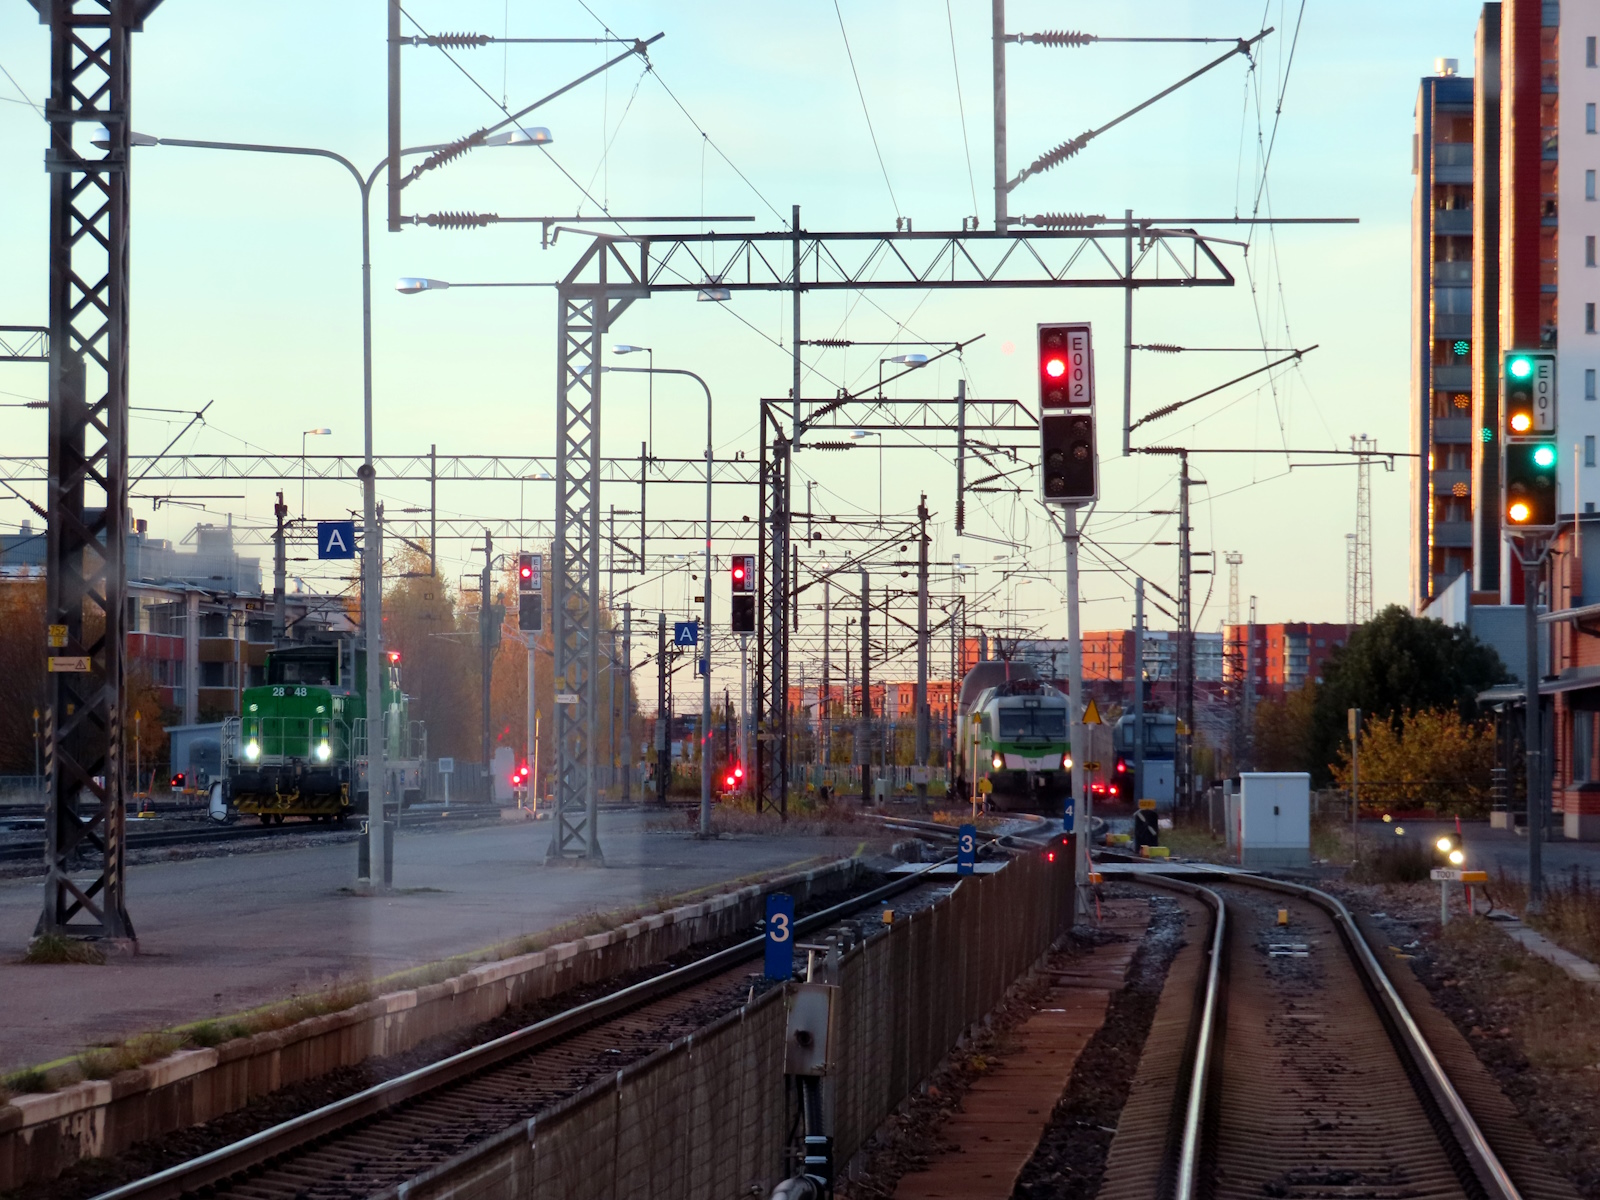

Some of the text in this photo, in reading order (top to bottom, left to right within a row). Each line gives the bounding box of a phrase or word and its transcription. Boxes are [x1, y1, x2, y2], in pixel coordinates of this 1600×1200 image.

[1072, 337, 1084, 397] E002
[1538, 365, 1549, 425] E001
[326, 529, 347, 552] A
[50, 625, 67, 636] 752
[680, 626, 693, 641] A
[272, 687, 307, 697] 28 48
[1065, 805, 1073, 816] 4
[961, 835, 973, 853] 3
[1436, 871, 1455, 879] T001
[770, 913, 790, 943] 3
